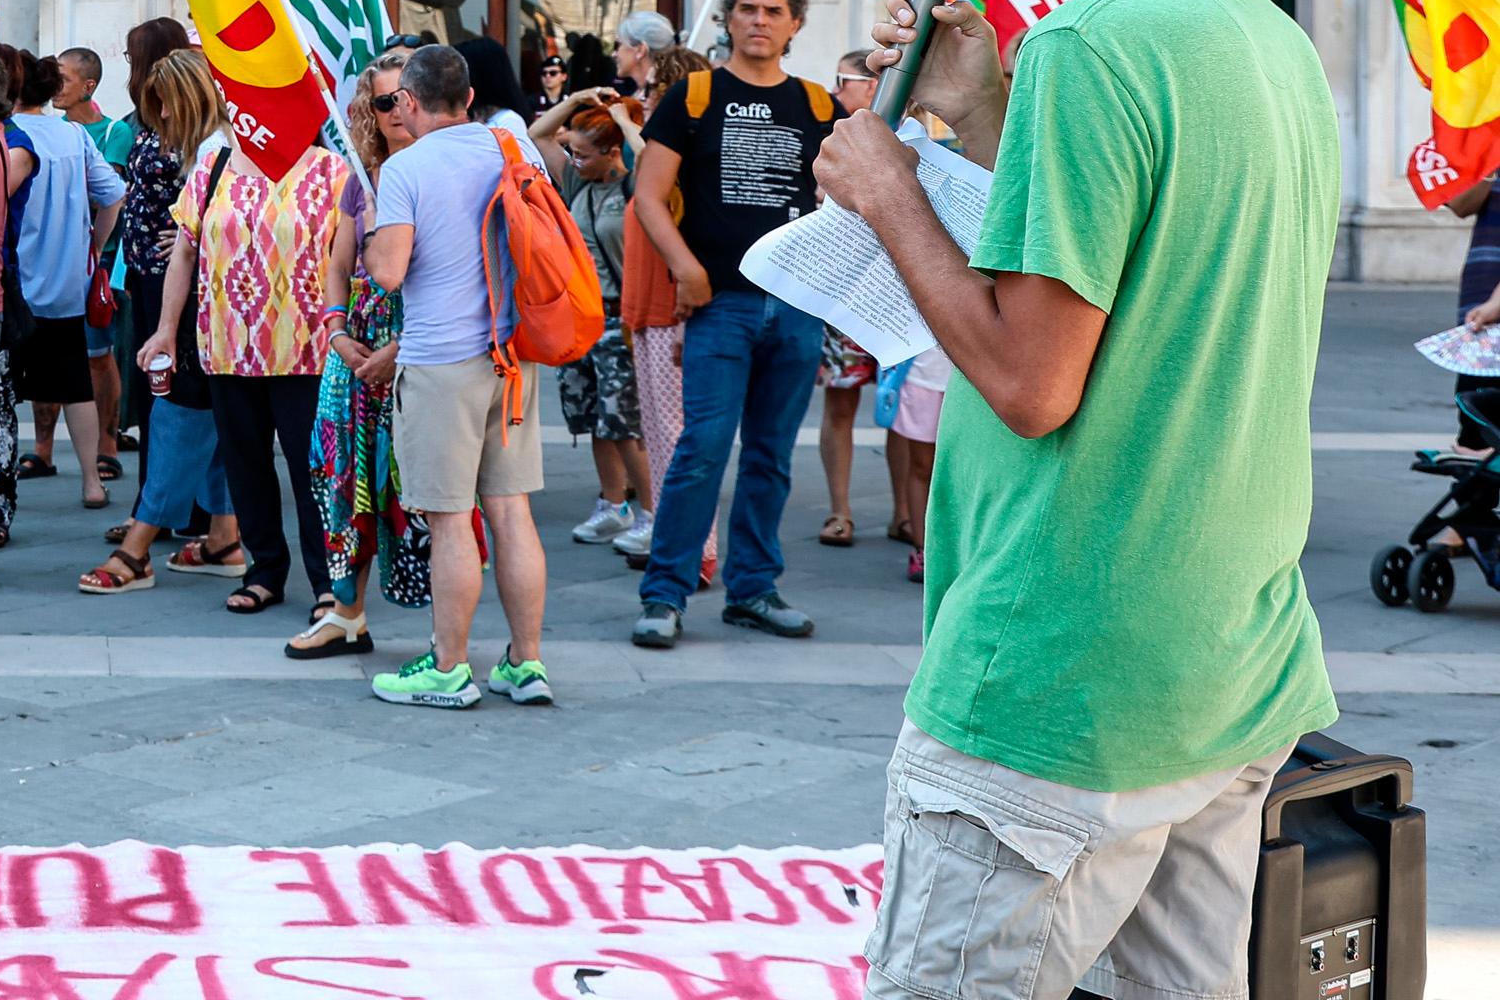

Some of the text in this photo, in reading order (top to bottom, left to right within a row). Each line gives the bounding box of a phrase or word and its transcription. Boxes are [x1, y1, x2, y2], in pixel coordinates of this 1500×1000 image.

[725, 102, 772, 118] Caffè
[411, 693, 464, 706] SCARPA
[248, 851, 882, 934] UCAZIONE
